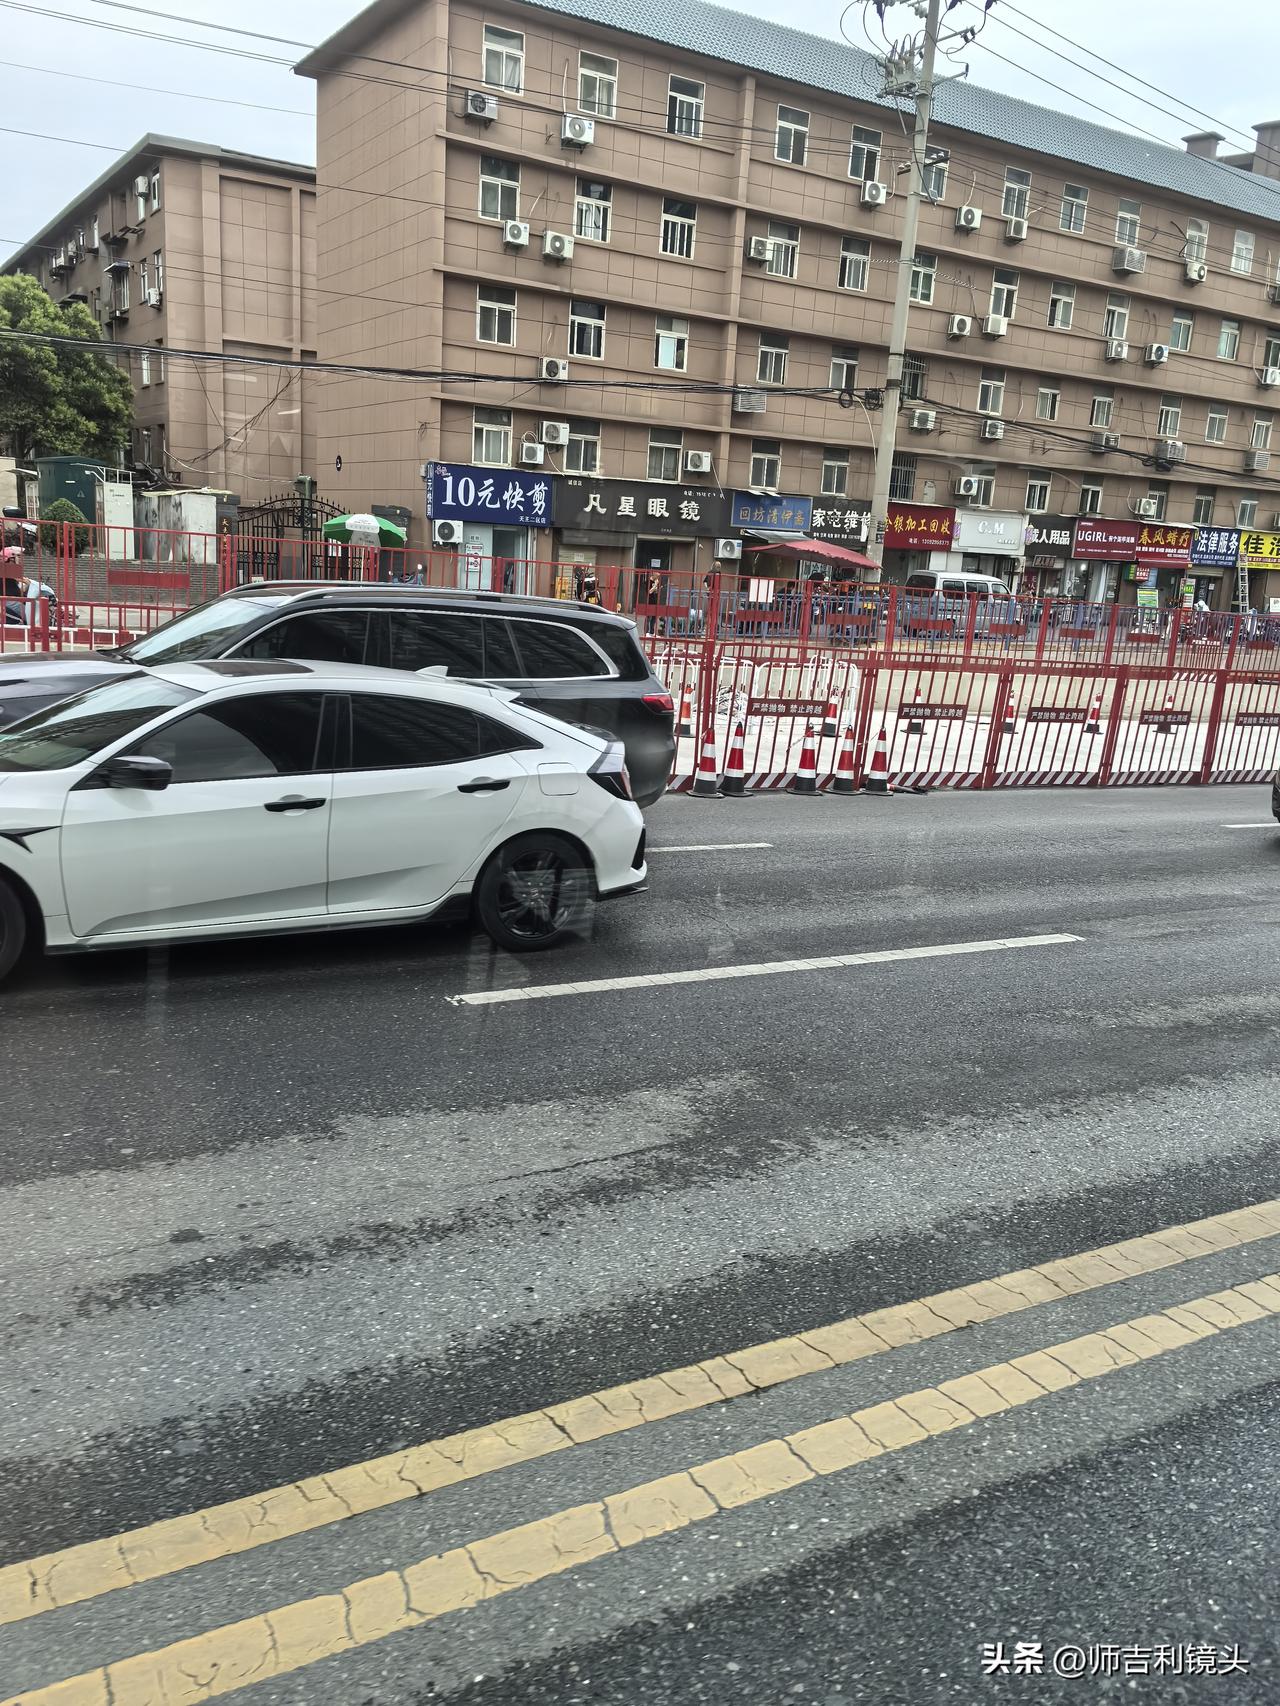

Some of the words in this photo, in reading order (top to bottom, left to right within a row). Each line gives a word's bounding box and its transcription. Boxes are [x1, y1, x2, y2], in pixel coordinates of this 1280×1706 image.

[442, 476, 548, 515] 10元快剪
[584, 493, 701, 521] 凡星眼镜
[1032, 528, 1070, 545] 成人用品
[1078, 530, 1107, 542] UGIRL
[1197, 530, 1238, 555] 法律服务
[752, 703, 786, 712] 严禁抛物
[790, 704, 822, 714] 禁止跨越
